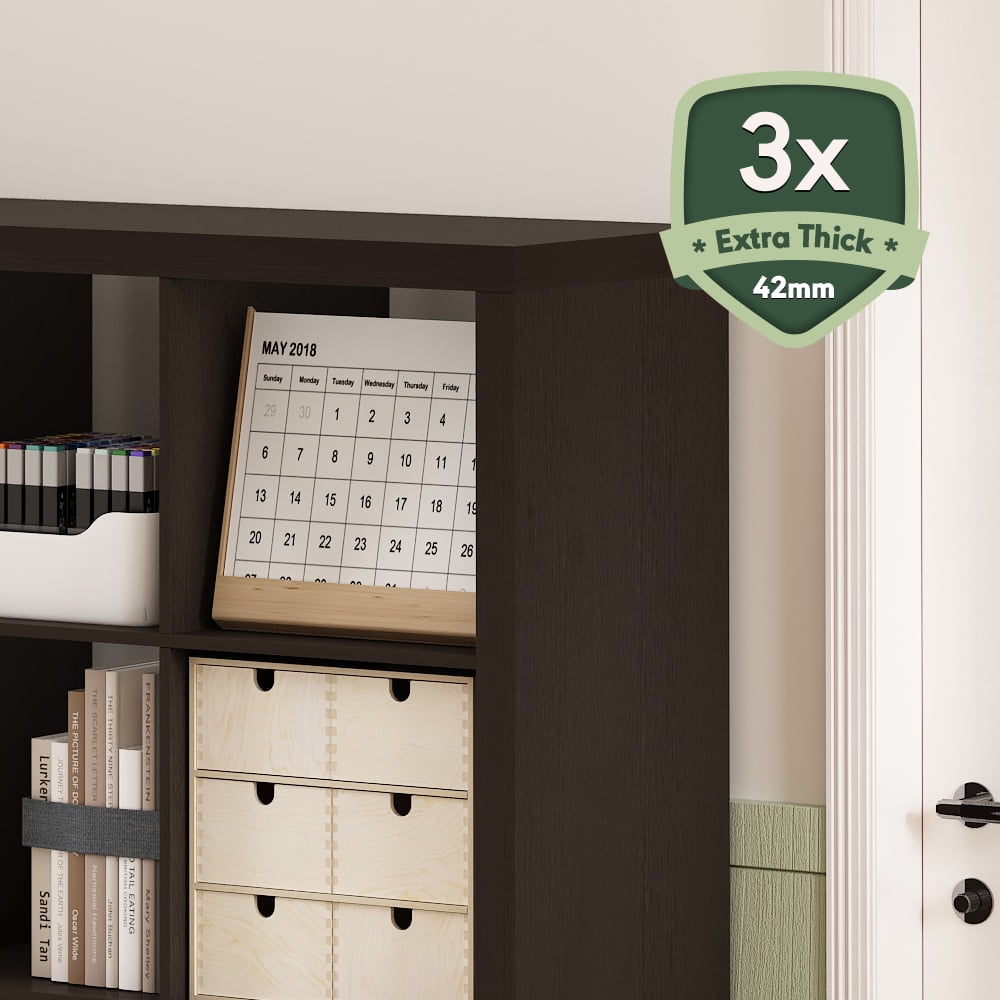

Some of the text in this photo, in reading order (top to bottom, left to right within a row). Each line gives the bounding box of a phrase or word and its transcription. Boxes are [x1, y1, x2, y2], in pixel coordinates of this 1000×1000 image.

[262, 340, 317, 358] MAY 2018
[263, 374, 460, 392] Sunday Monday Tuesday Wednesday Thursday Friday
[264, 404, 446, 426] 29 30 1 2 3 4
[262, 446, 268, 460] 6
[298, 448, 304, 461] 7
[332, 449, 338, 463] 8
[367, 451, 374, 465] 9
[400, 454, 412, 468] 10
[436, 456, 446, 470] 11
[255, 489, 476, 515] 13 14 15 16 17 18 19
[249, 531, 474, 558] 20 21 22 23 24 25 26
[72, 777, 79, 789] OF
[58, 859, 64, 870] OF
[40, 891, 51, 962] Sandi Tan
